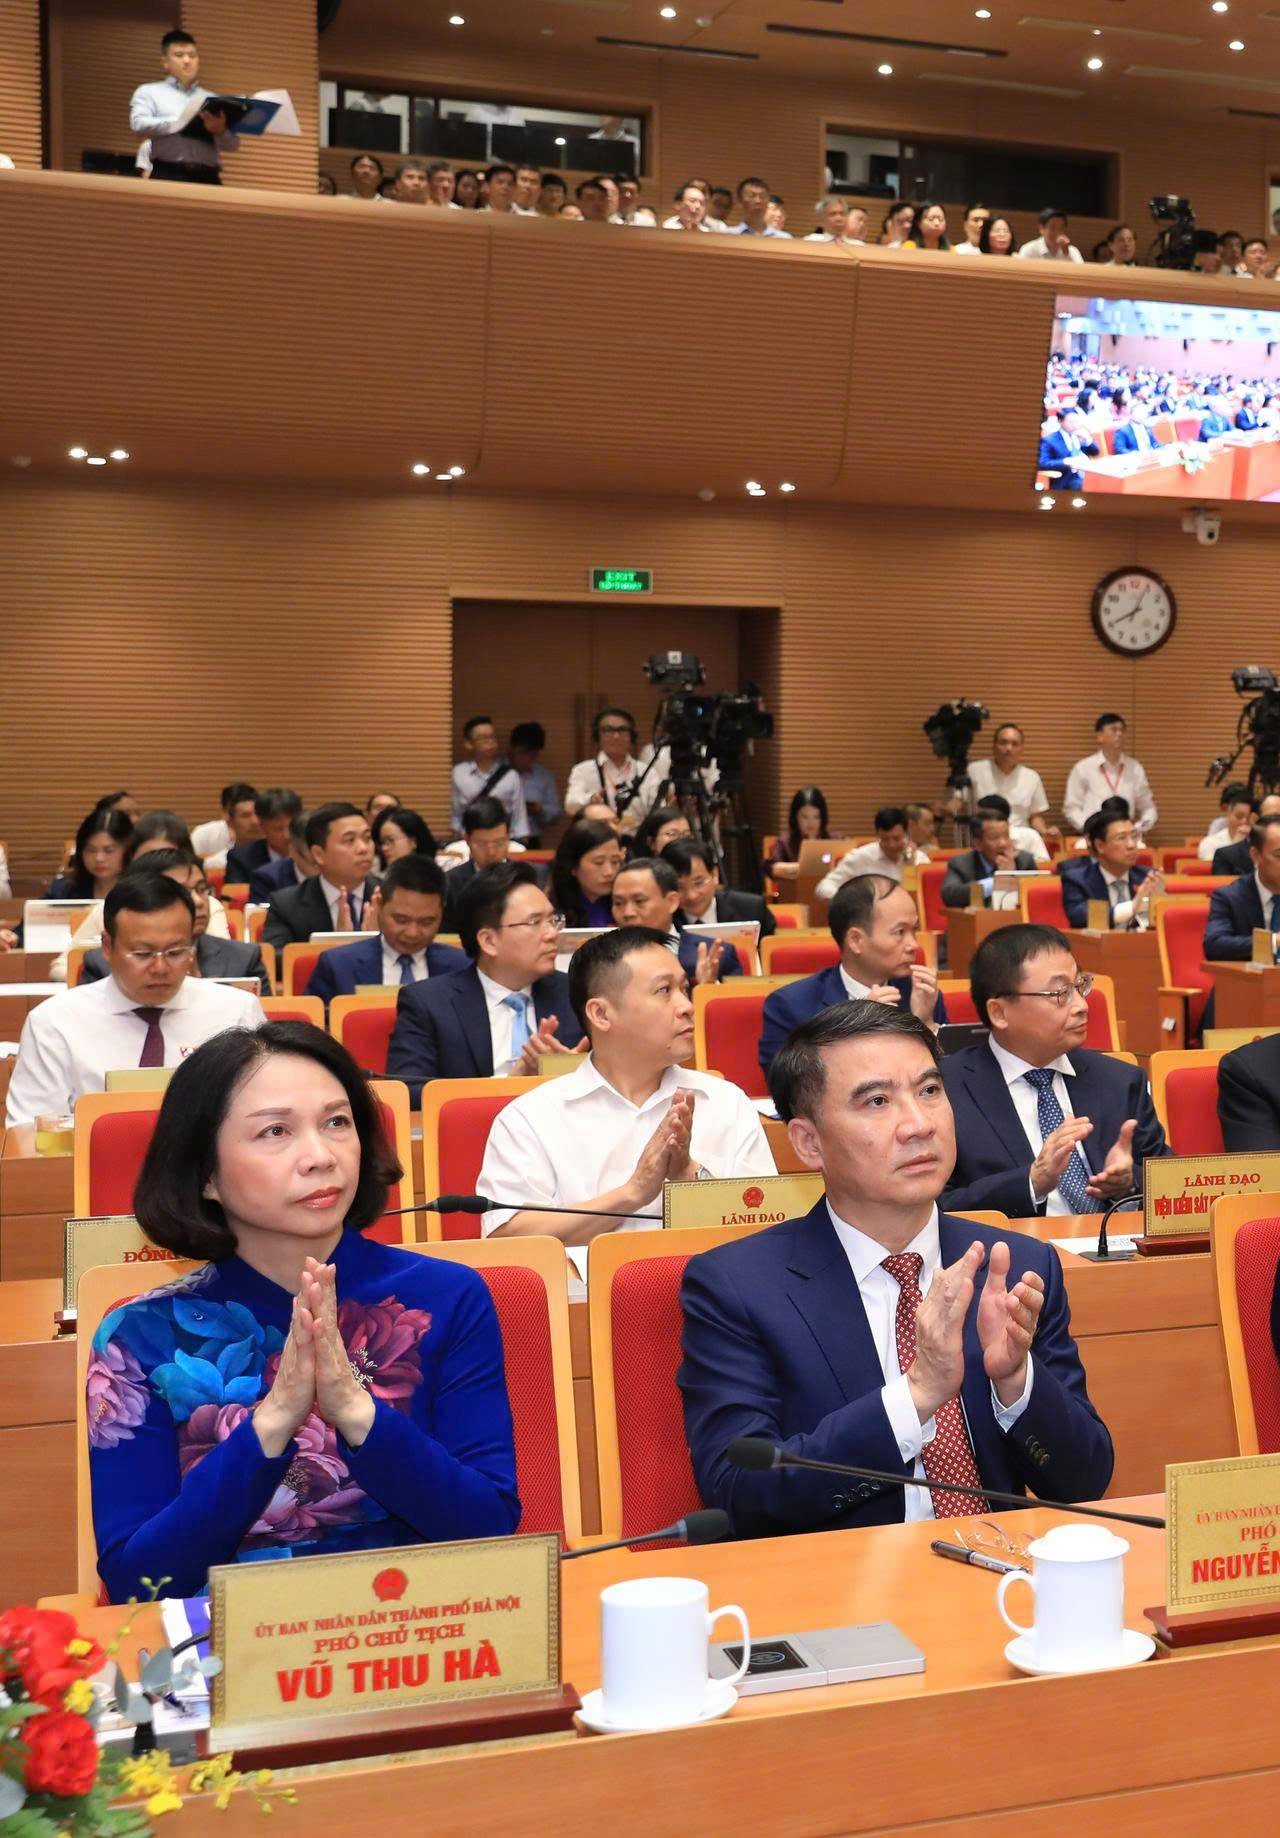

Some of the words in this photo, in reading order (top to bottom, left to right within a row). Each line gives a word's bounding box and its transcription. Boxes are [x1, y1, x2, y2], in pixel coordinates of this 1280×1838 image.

[1184, 1174, 1225, 1187] LÃNH
[1229, 1173, 1261, 1186] ĐẠO
[721, 1212, 756, 1225] LÃNH
[1196, 1510, 1211, 1524] ỦY
[1215, 1510, 1237, 1522] BAN
[1238, 1503, 1272, 1520] NHÂN
[1240, 1518, 1276, 1542] PHÓ
[255, 1621, 275, 1638] ỦY
[279, 1620, 308, 1636] BAN
[314, 1613, 355, 1631] NHÂN
[358, 1608, 387, 1626] DÂN
[390, 1604, 438, 1623] THÀNH
[442, 1597, 471, 1617] PHỐ
[473, 1597, 492, 1613] HÀ
[495, 1594, 521, 1612] NỘI
[313, 1631, 360, 1653] PHÓ
[364, 1623, 409, 1648] CHỦ
[414, 1622, 465, 1644] TỊCH
[276, 1659, 333, 1702] VŨ
[347, 1653, 429, 1693] THU
[443, 1638, 501, 1683] HÀ
